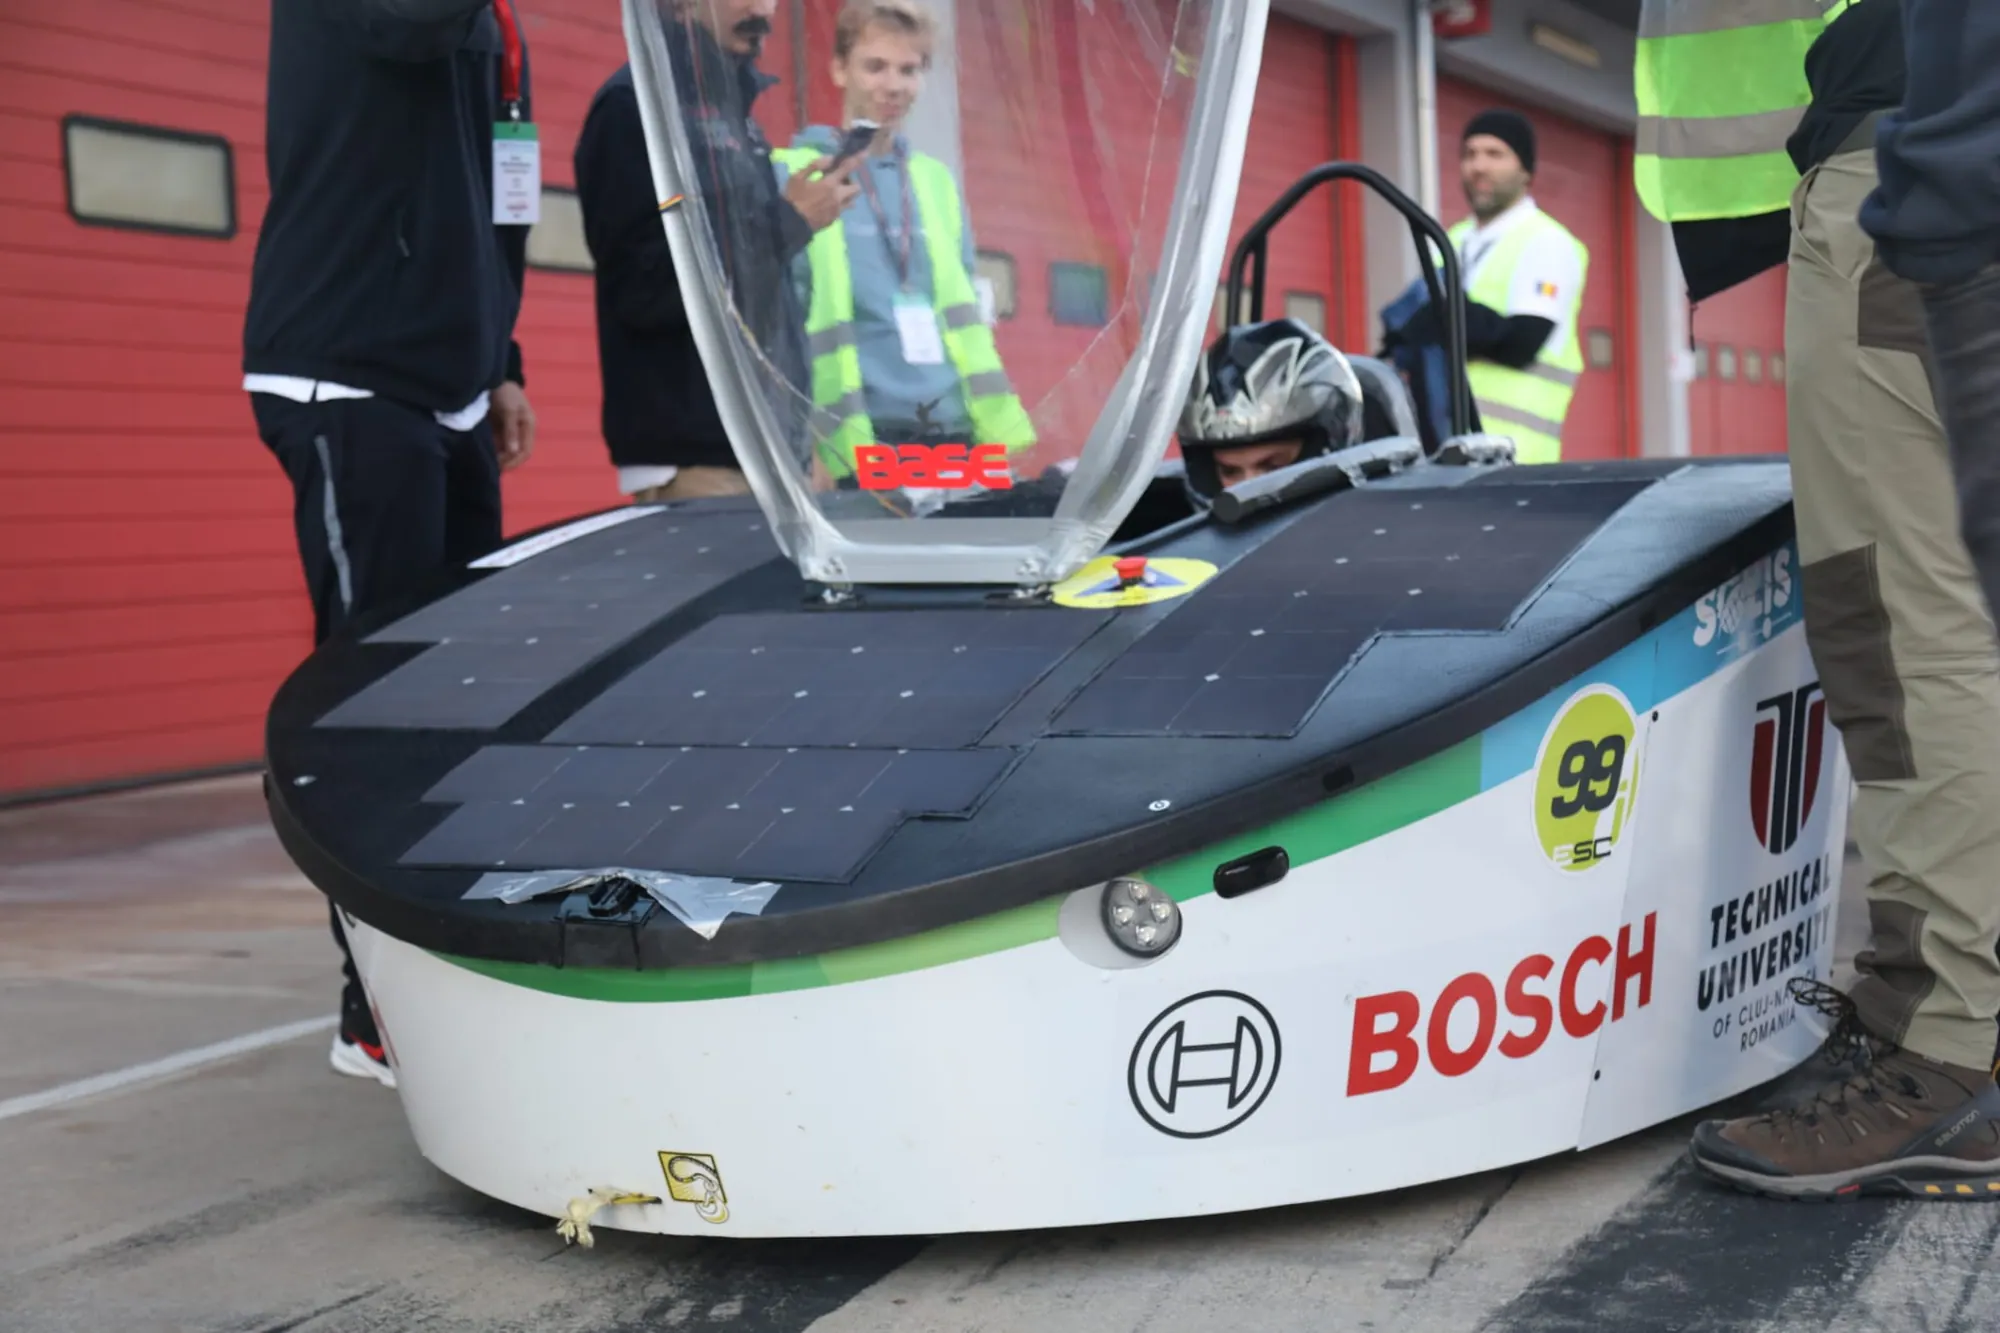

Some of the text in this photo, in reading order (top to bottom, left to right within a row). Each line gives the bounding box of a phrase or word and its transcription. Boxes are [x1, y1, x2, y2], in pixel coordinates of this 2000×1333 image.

[1551, 734, 1625, 819] 99
[1711, 852, 1830, 949] TECHNICAL
[1697, 903, 1831, 1012] UNIVERSITY
[1346, 910, 1657, 1097] BOSCH
[1713, 1013, 1731, 1038] OF
[1741, 1005, 1796, 1052] ROMANIA
